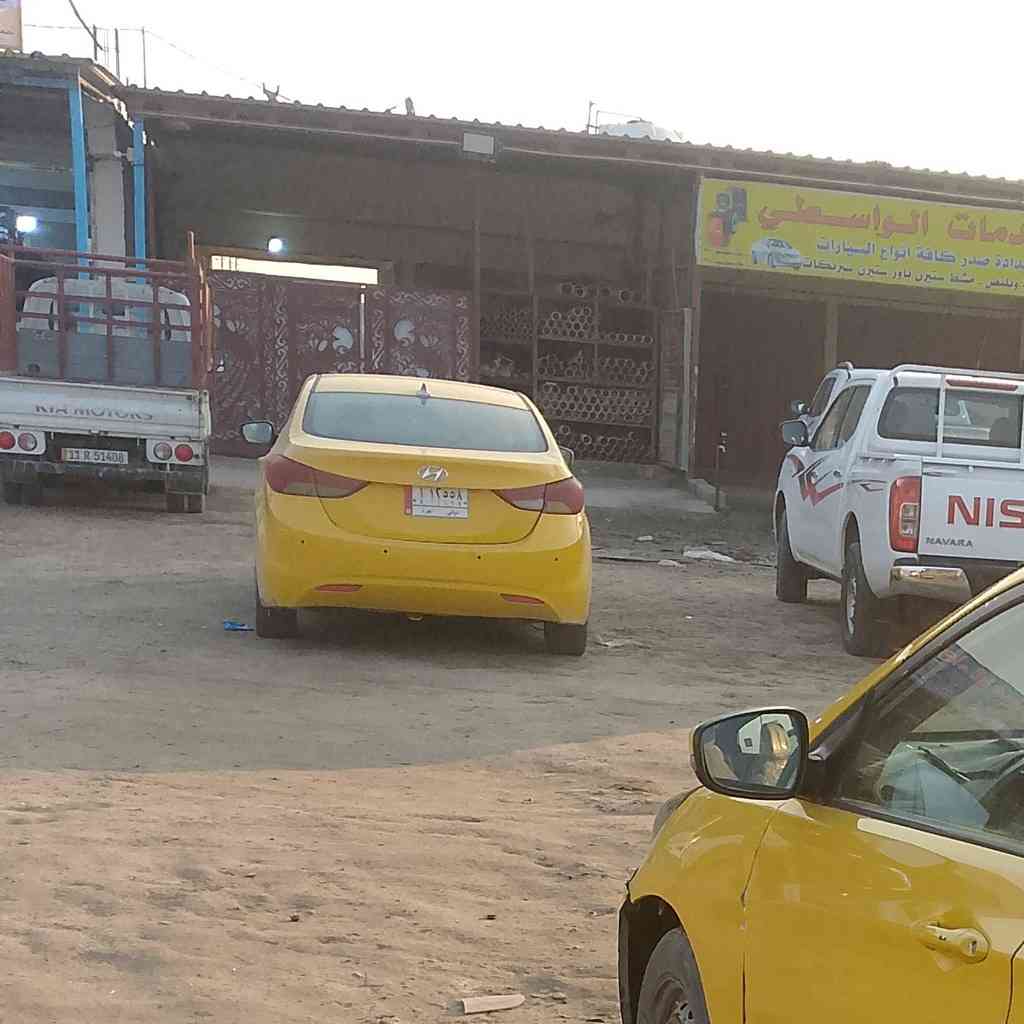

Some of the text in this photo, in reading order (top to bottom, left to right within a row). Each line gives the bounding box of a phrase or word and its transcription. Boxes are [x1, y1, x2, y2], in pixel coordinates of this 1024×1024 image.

[758, 193, 929, 239] الواسطي
[815, 237, 876, 257] السيارات
[916, 243, 956, 263] كافة
[960, 255, 991, 269] صدر
[925, 537, 974, 548] NAVARA
